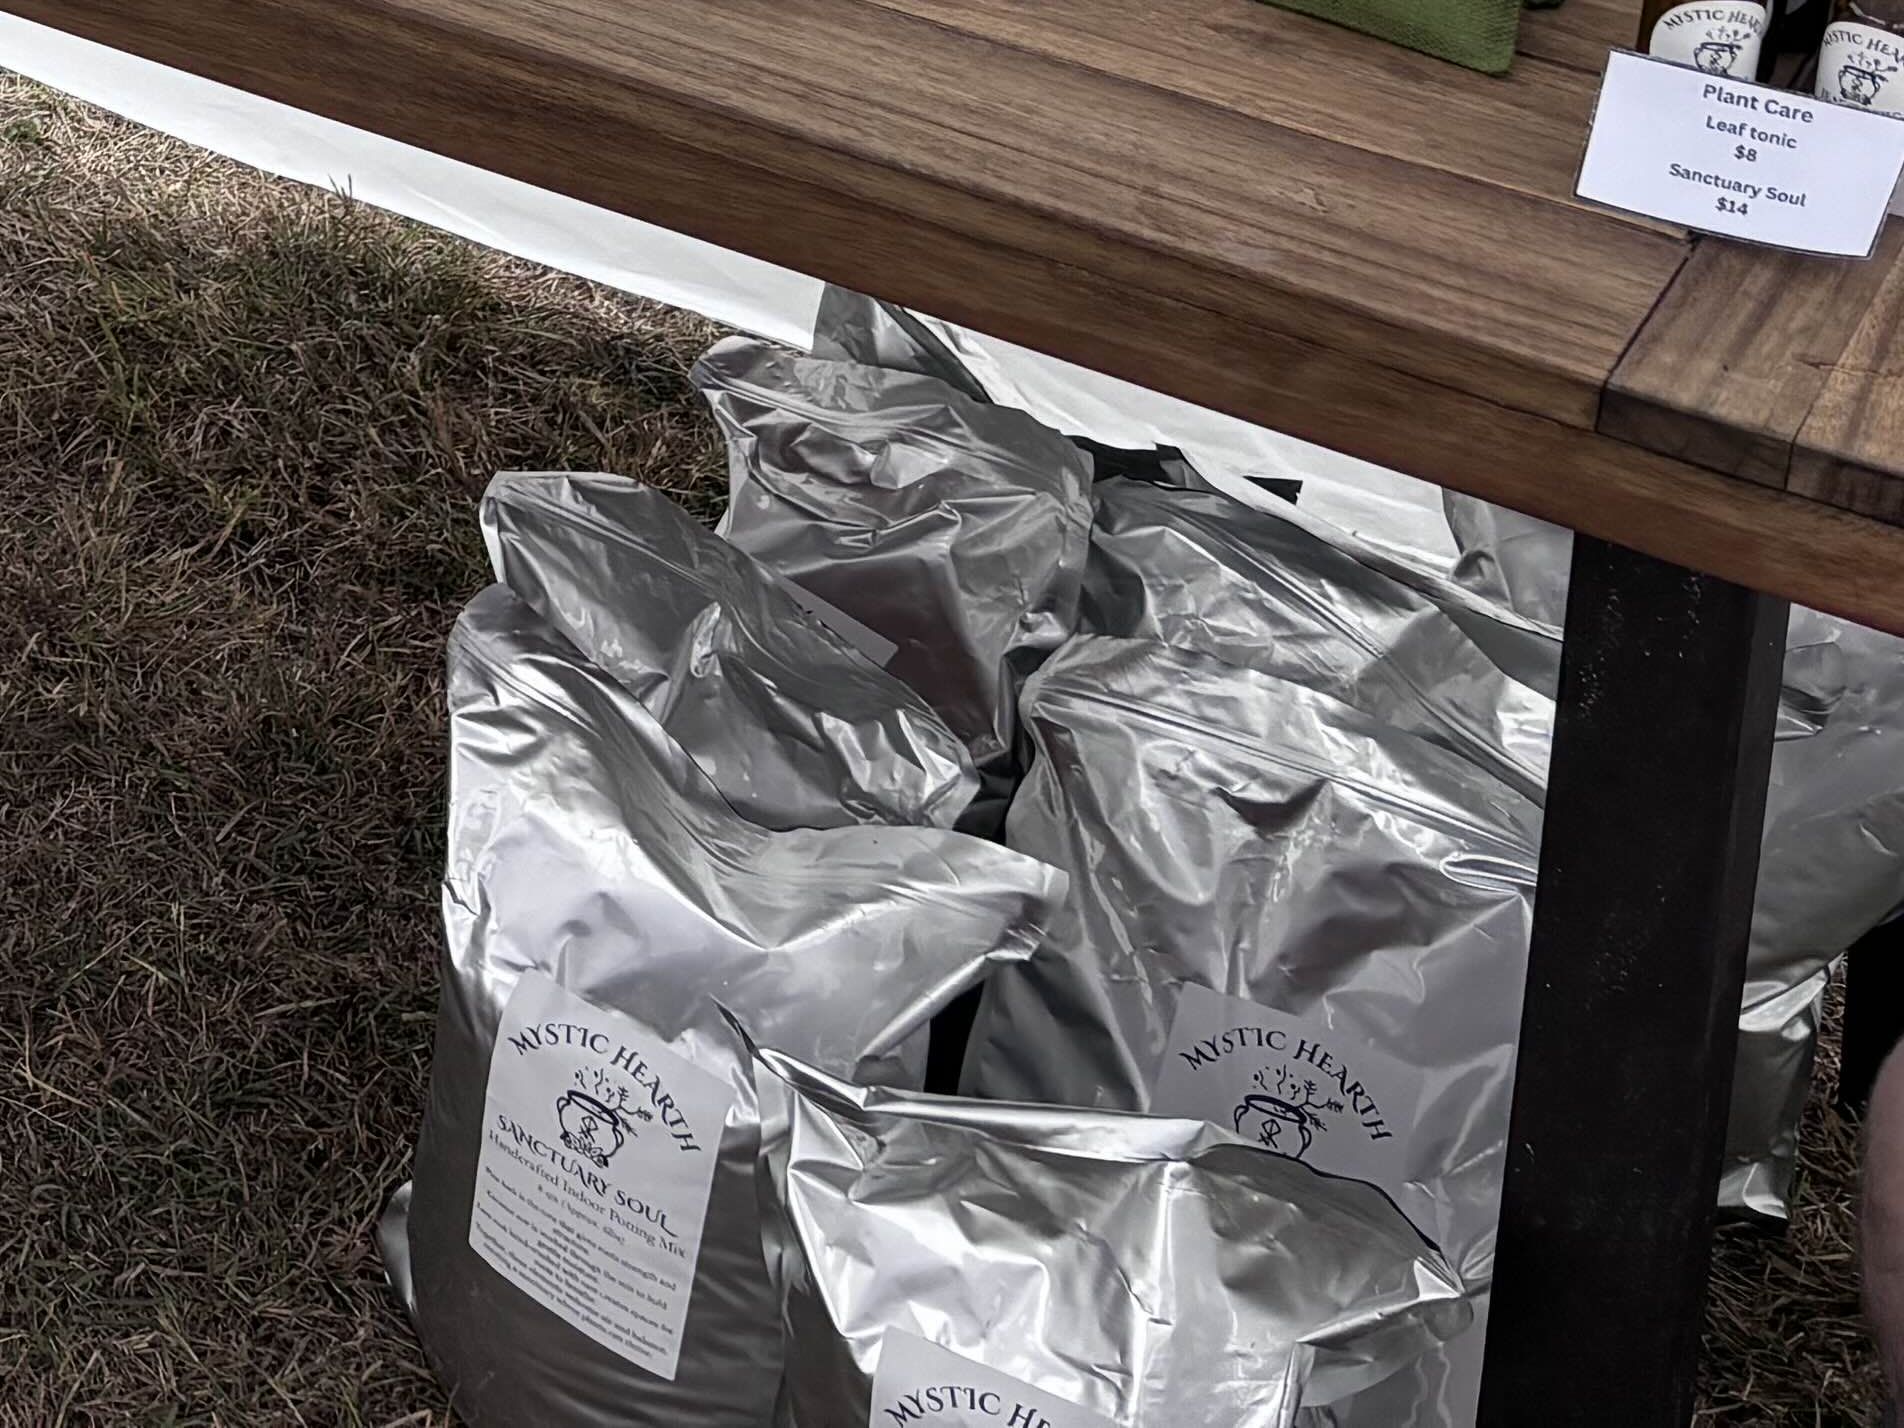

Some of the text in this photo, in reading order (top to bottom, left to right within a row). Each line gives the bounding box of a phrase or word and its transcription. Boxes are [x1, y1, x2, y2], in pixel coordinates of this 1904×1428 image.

[1662, 9, 1726, 30] MYSTIC
[1702, 83, 1814, 126] Plant Care
[1706, 114, 1798, 150] Leaf tonic
[1734, 144, 1758, 163] $8
[1669, 161, 1807, 209] Sanctuary Soul
[1716, 195, 1749, 217] $14
[507, 1022, 703, 1154] MYSTIC HEARTH
[1177, 1026, 1393, 1143] MYSTIC HEARTH
[488, 1128, 560, 1188] Handcrafted
[561, 1170, 606, 1214] Indoor
[608, 1208, 657, 1243] Potting
[658, 1236, 687, 1259] Mix
[496, 1113, 613, 1198] SANCTUARY
[614, 1188, 679, 1239] SOUL
[883, 1385, 1001, 1428] MYSTIC
